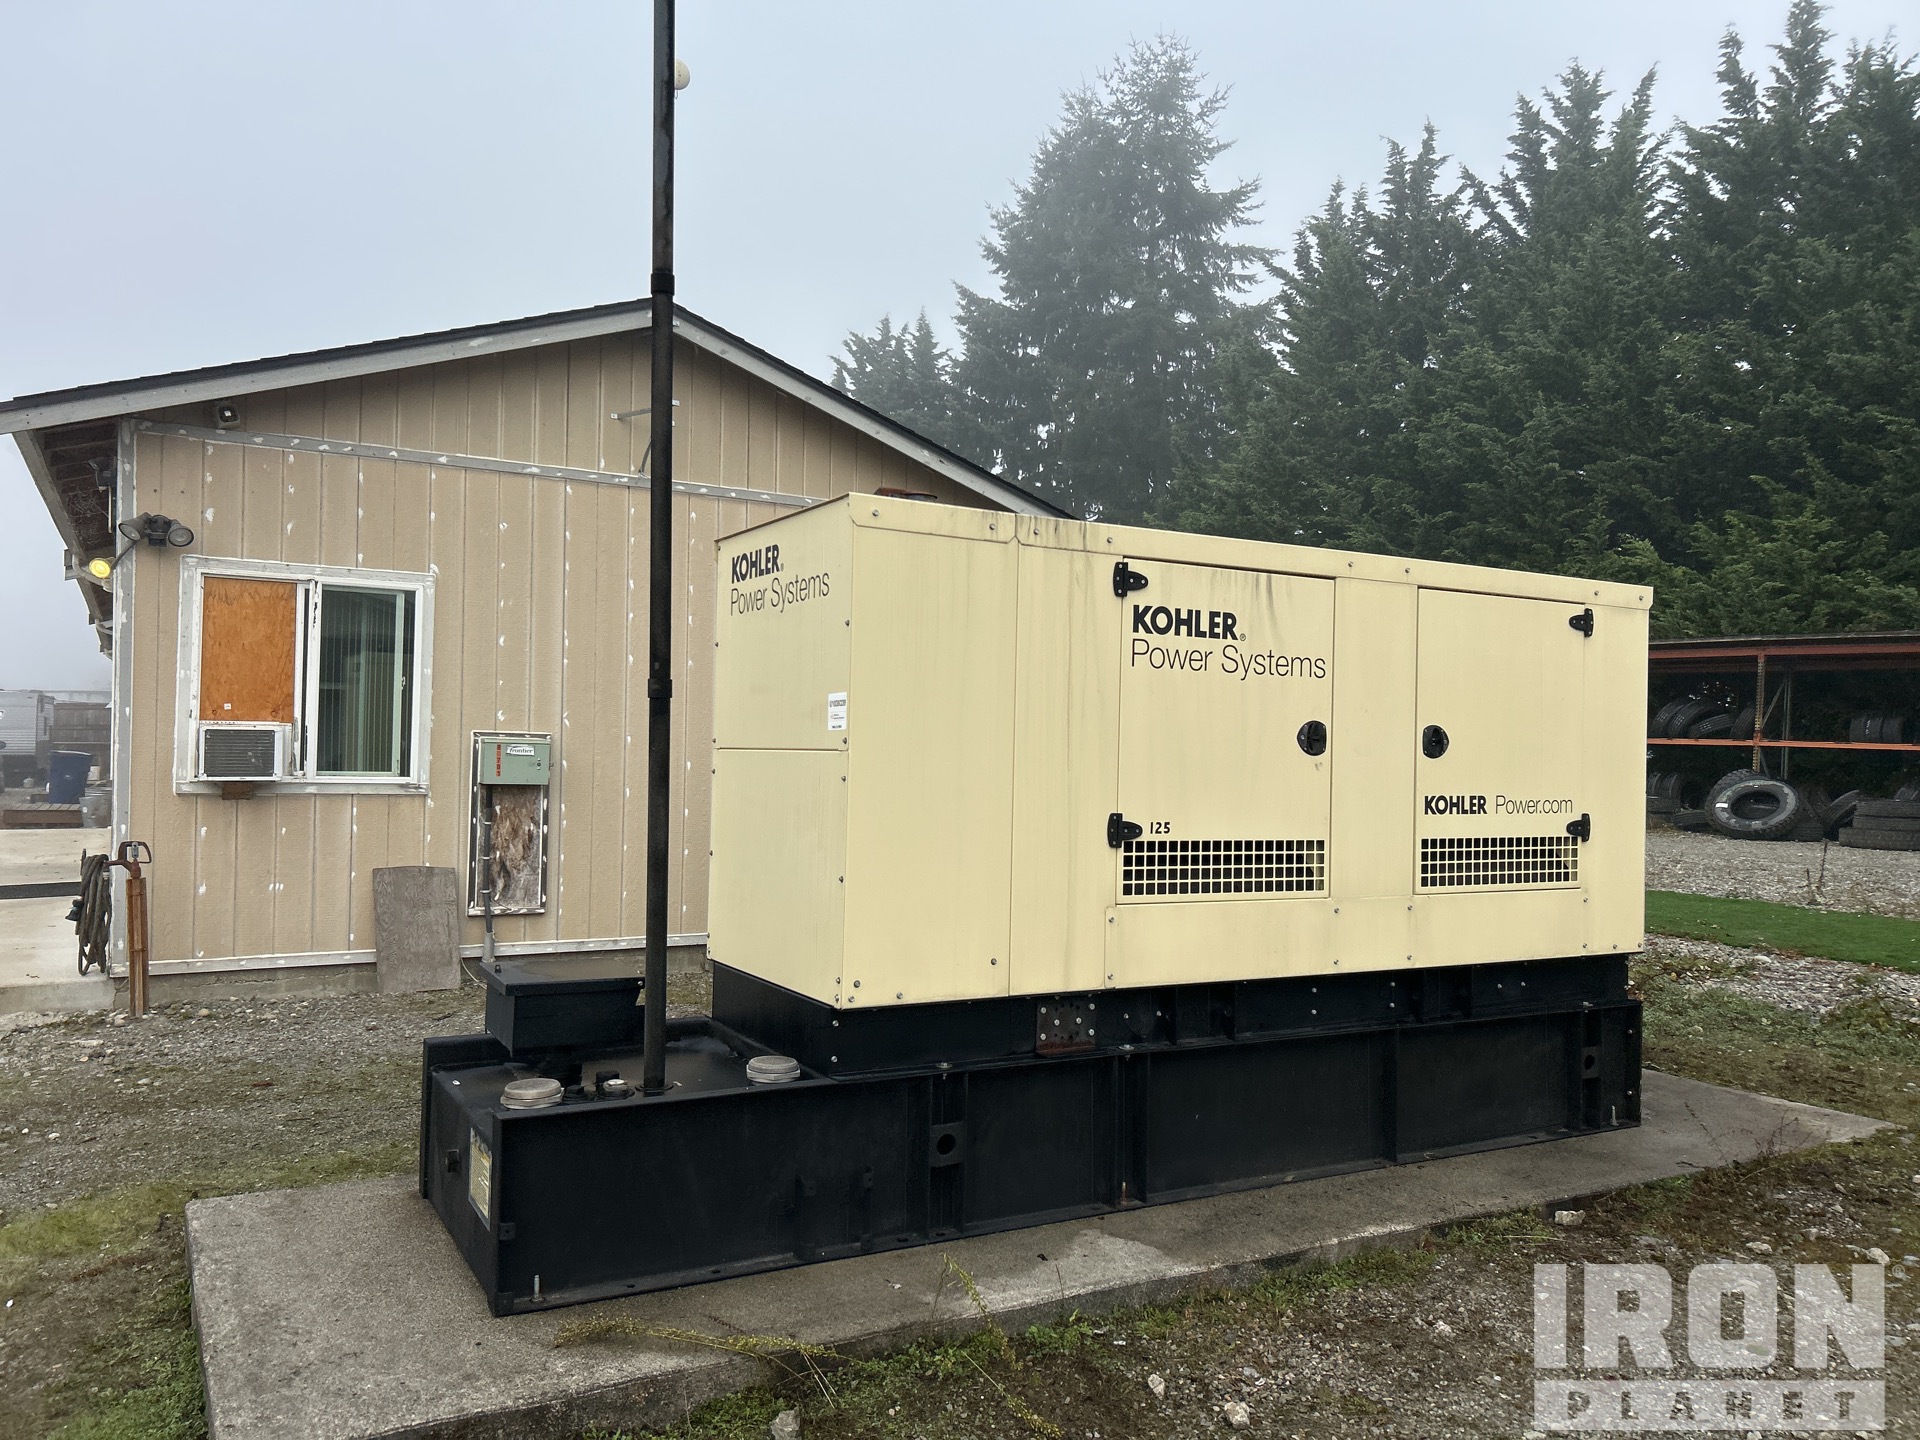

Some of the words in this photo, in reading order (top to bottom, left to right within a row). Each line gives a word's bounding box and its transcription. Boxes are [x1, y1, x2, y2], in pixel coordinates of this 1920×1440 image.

[731, 544, 780, 584] KOHLER
[730, 587, 767, 616] Power
[770, 572, 830, 613] Systems
[1132, 604, 1239, 641] KOHLER
[1131, 638, 1213, 672] Power
[1221, 644, 1326, 681] Systems
[1424, 795, 1488, 815] KOHLER
[1495, 795, 1573, 814] Power.com
[1150, 821, 1171, 835] 125
